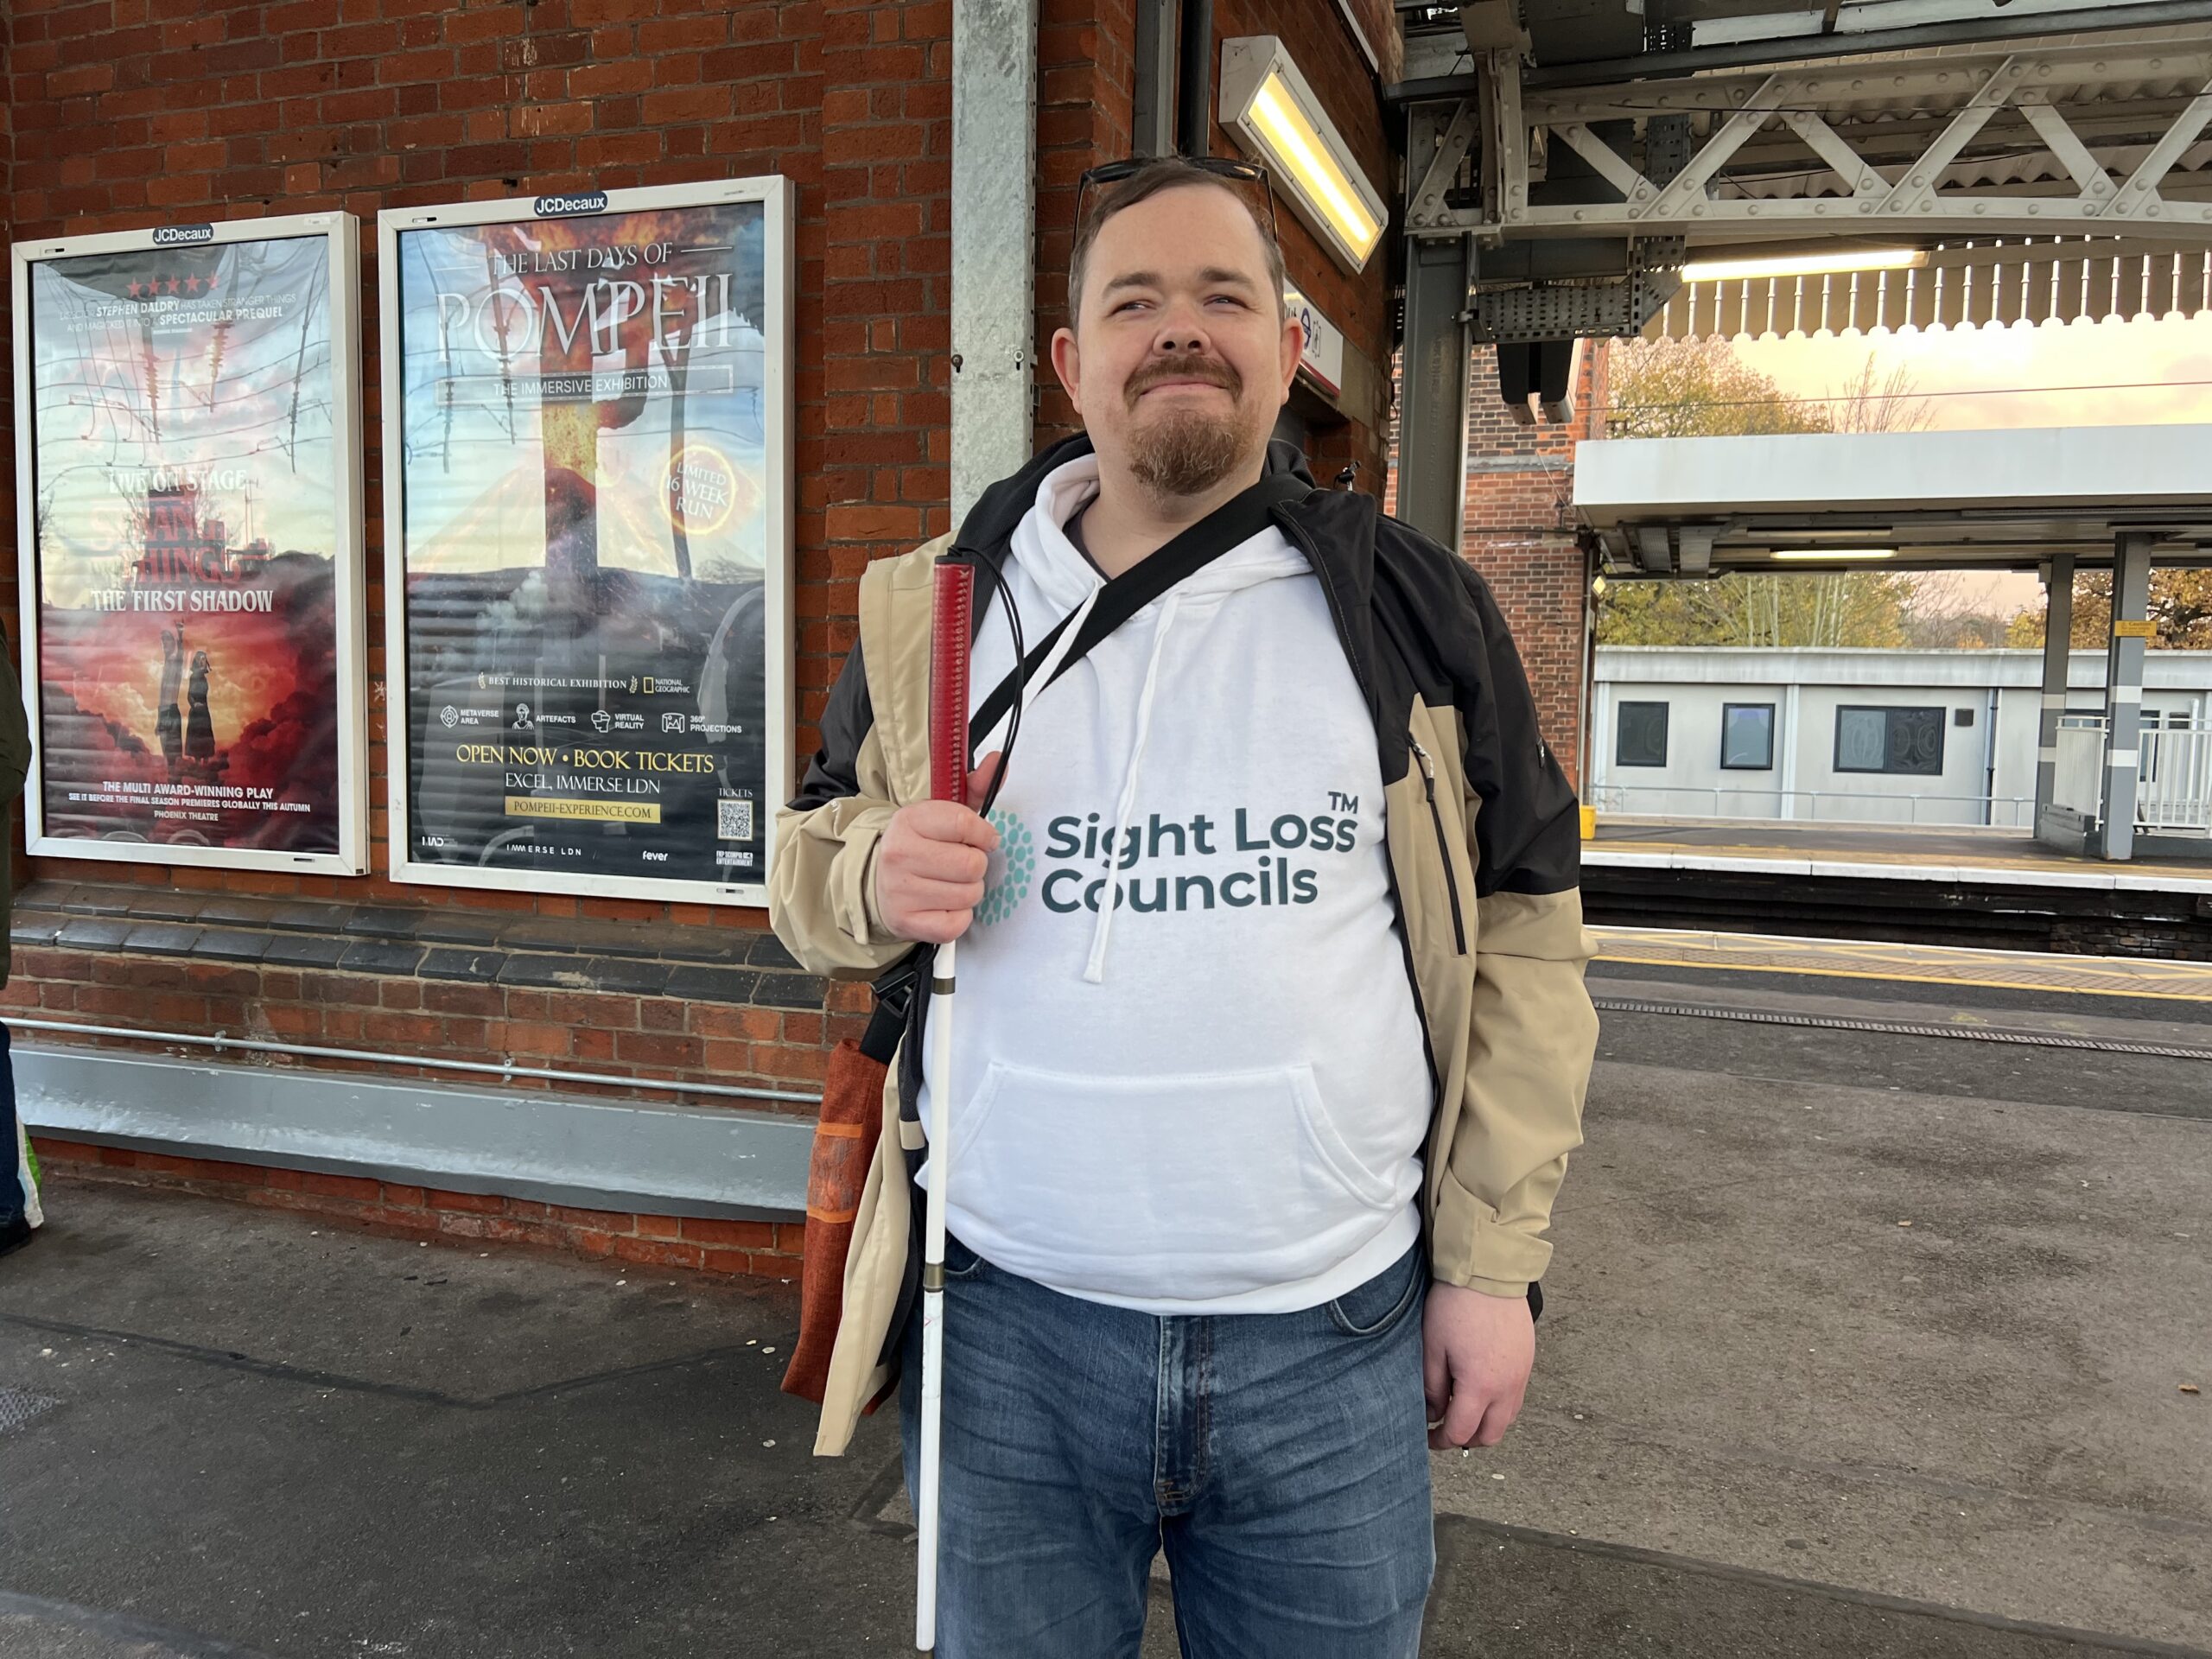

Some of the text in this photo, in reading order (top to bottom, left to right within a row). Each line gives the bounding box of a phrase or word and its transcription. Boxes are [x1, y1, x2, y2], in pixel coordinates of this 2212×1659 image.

[537, 197, 605, 213] JCDecaux
[155, 228, 211, 242] JCDecaux
[488, 241, 673, 275] THE LAST DAYS OF
[96, 303, 137, 317] STEPHEN
[140, 300, 180, 314] DALDRY
[159, 309, 232, 326] SPECTACULAR
[235, 306, 283, 321] PREQUEL
[435, 273, 734, 363] POMPEII
[493, 374, 668, 397] THE IMMERSIVE EXHIBITION
[109, 469, 247, 493] LIVE ON STAGE
[677, 461, 727, 486] LIMITED
[666, 474, 729, 507] 16 WEEK
[676, 496, 714, 519] RUN
[90, 589, 274, 613] THE FIRST SHADOW
[488, 677, 627, 689] BEST HISTORICAL EXHIBITION
[655, 685, 690, 694] GEOGRAPHIC
[460, 709, 499, 718] METAVERSE
[535, 715, 576, 724] ARTEFACTS
[614, 713, 645, 721] VIRTUAL
[614, 721, 645, 730] REALITY
[690, 724, 742, 734] PROJECTIONS
[456, 744, 715, 773] OPEN NOW BOOK TICKETS
[102, 780, 274, 800] THE MULTI AWARD-WINNING PLAY
[505, 772, 661, 794] EXCEL, IMMERSE LDN
[718, 787, 753, 798] TICKETS
[68, 792, 80, 801] SEE
[88, 793, 114, 803] BEFORE
[116, 795, 129, 804] THE
[129, 796, 149, 804] FINAL
[150, 797, 180, 806] SEASON
[181, 798, 220, 808] PREMIERES
[221, 799, 260, 810] GLOBALLY
[262, 801, 278, 811] THIS
[279, 803, 311, 812] AUTUMN
[513, 800, 652, 819] POMPEII-EXPERIENCE.COM
[1327, 791, 1359, 814] TM
[154, 810, 219, 822] PHOENIX THEATRE
[1044, 807, 1359, 871] Sight Loss
[506, 843, 582, 856] IMMERSE LDN
[642, 850, 669, 861] fever
[1041, 855, 1318, 913] Councils
